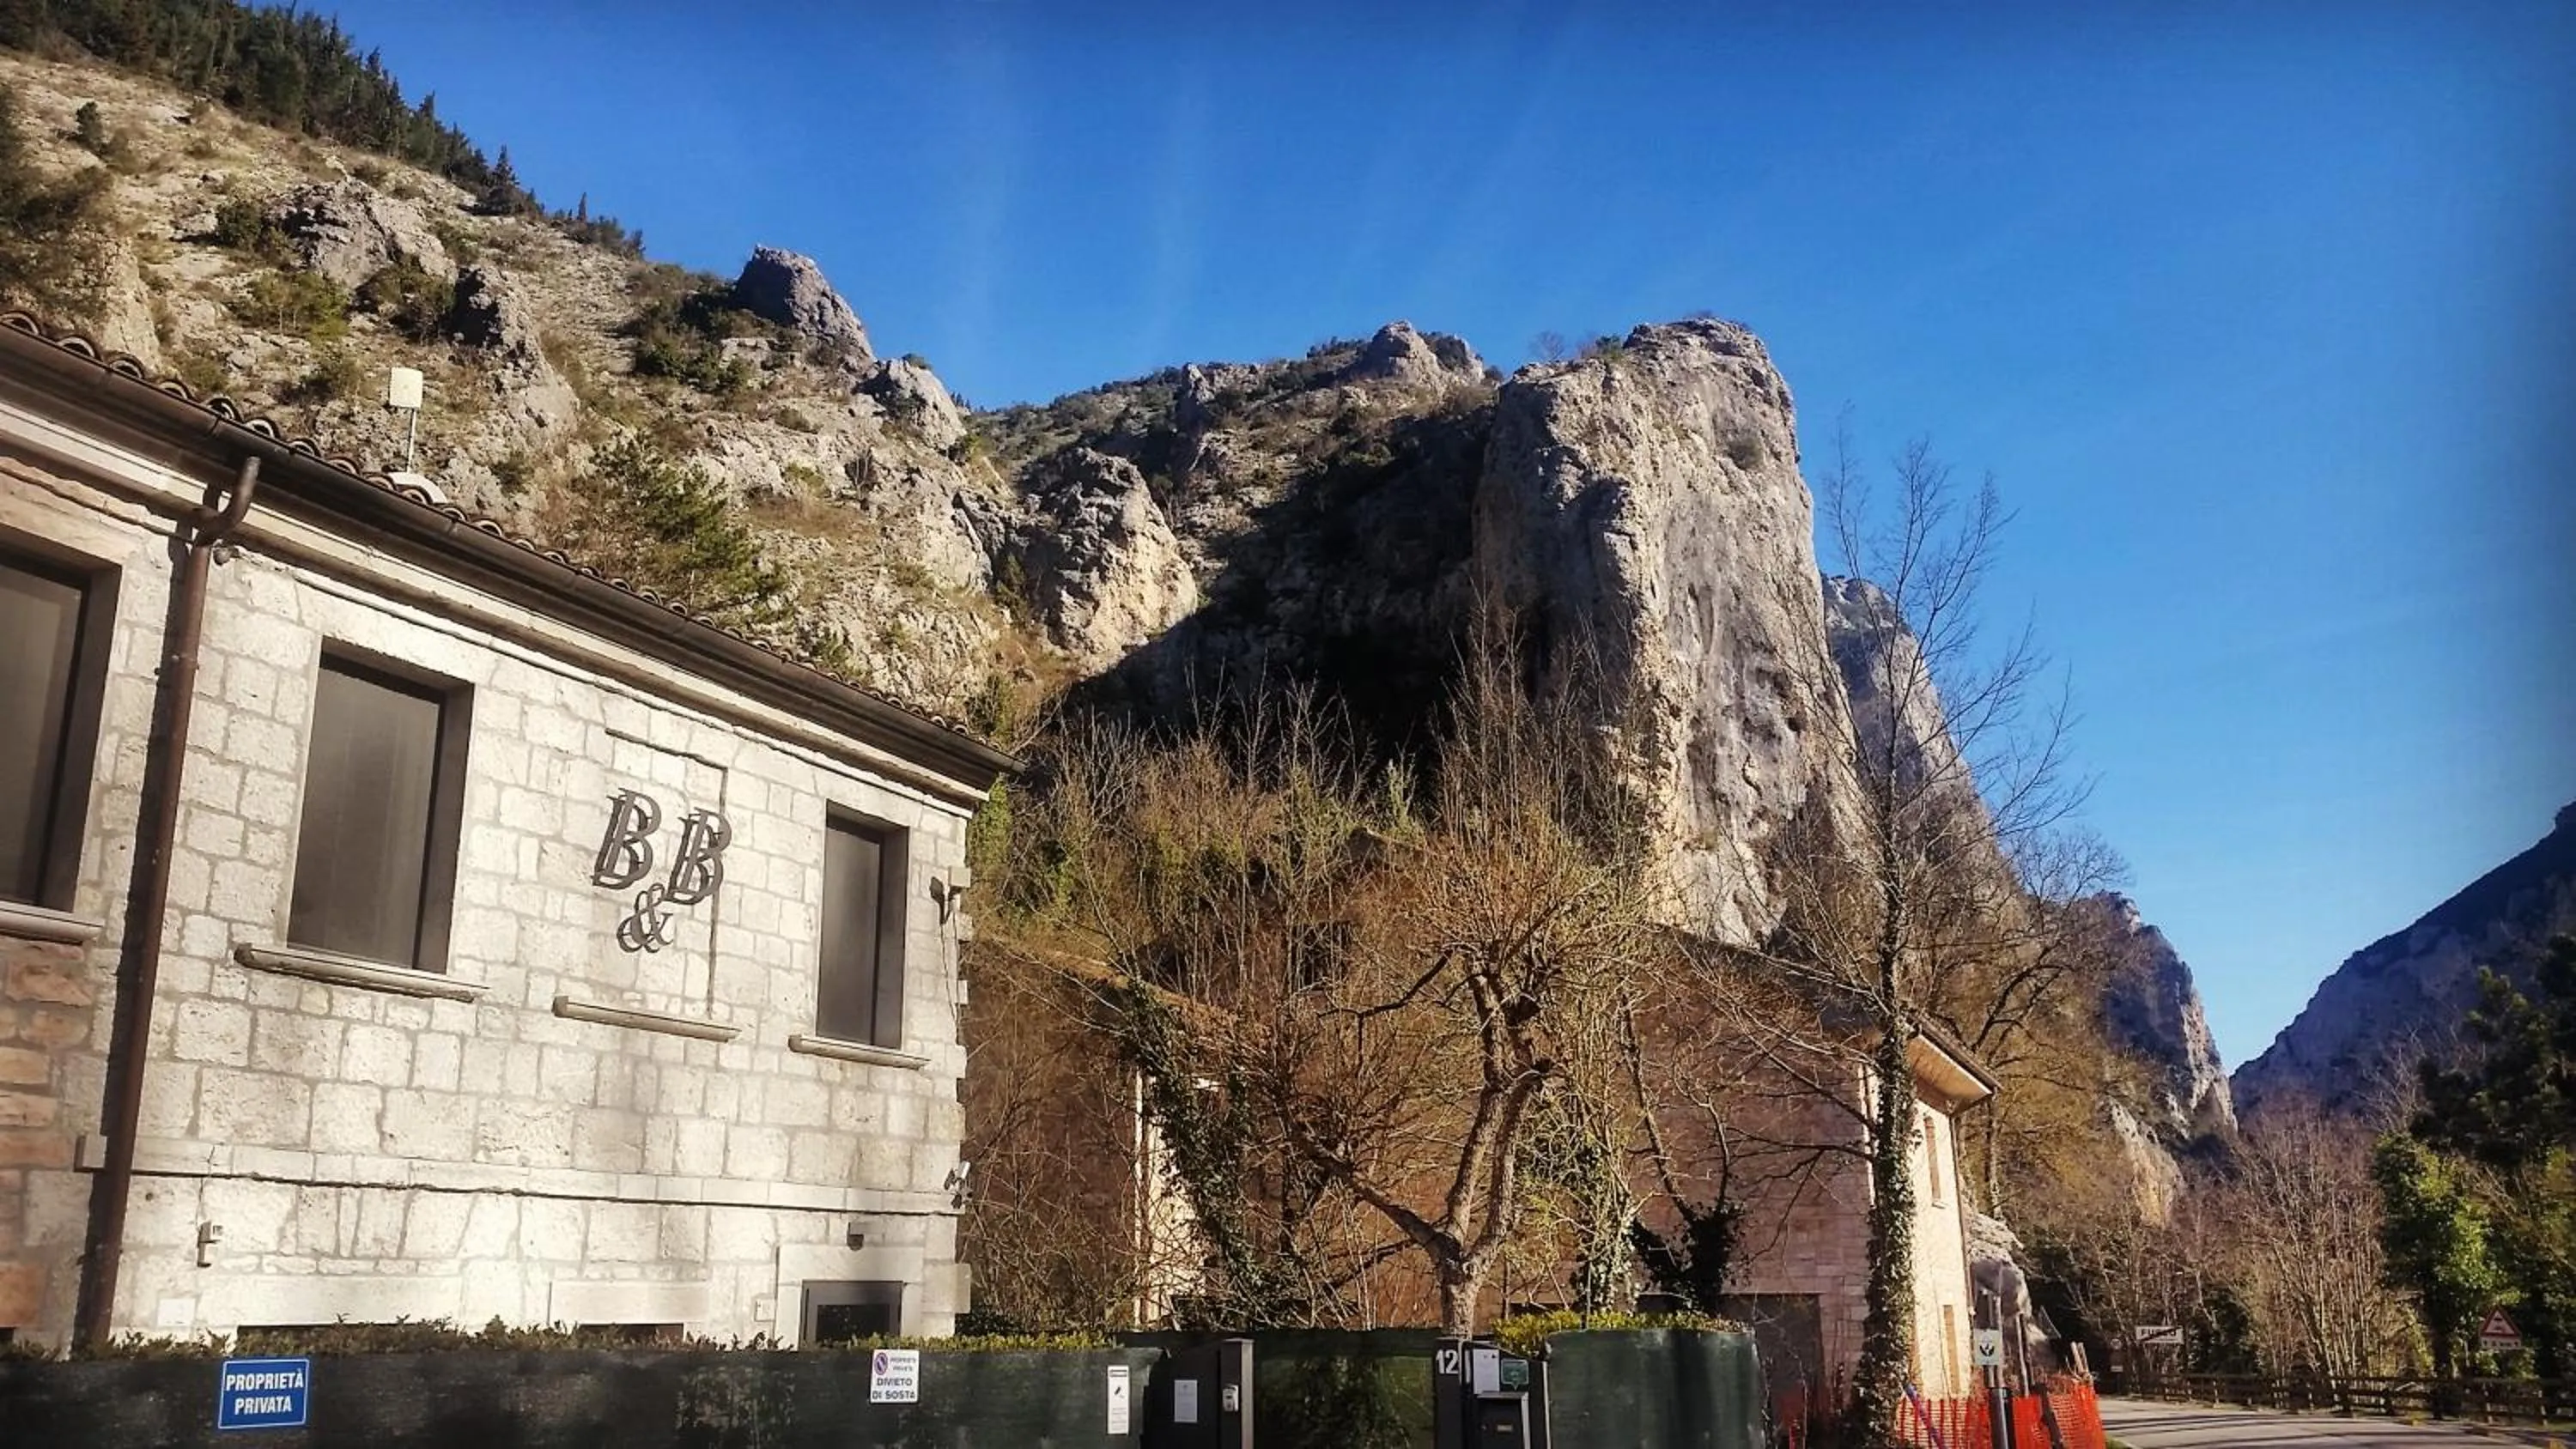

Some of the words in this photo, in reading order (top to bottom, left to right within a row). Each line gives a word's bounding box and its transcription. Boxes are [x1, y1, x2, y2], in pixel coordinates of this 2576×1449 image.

[1435, 1349, 1459, 1374] 12
[226, 1368, 304, 1391] PROPRIETÀ
[877, 1378, 913, 1386] DIVIETO
[872, 1391, 883, 1400] DI
[885, 1390, 916, 1400] SOSTA
[234, 1396, 292, 1415] PRIVATA
